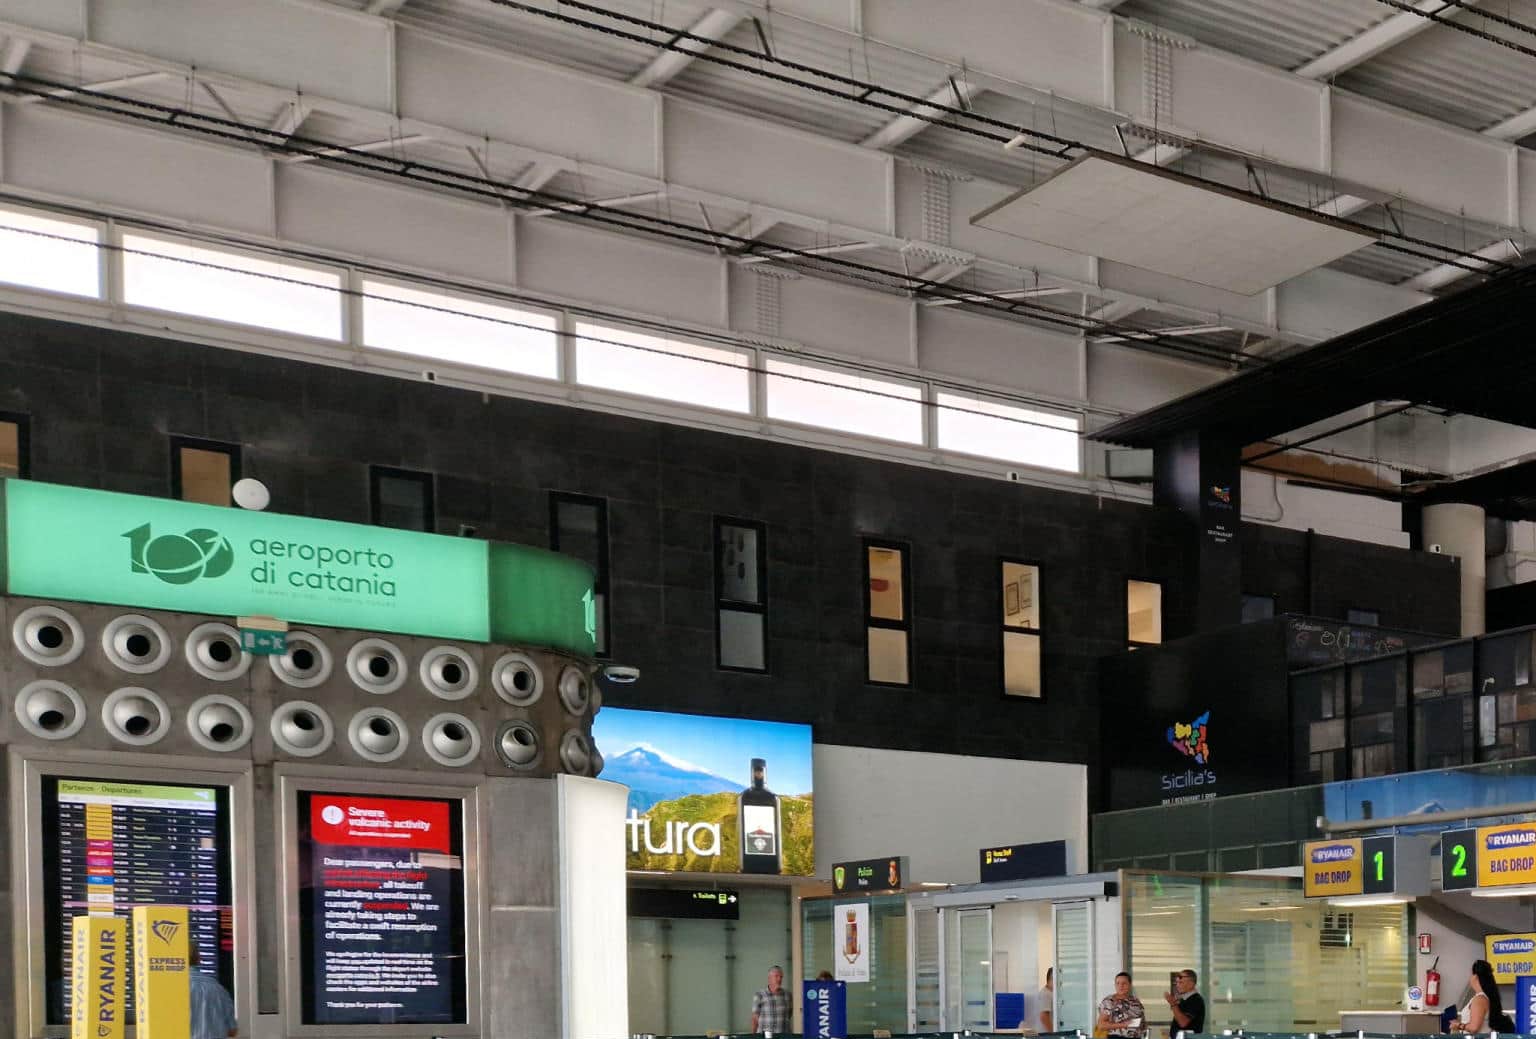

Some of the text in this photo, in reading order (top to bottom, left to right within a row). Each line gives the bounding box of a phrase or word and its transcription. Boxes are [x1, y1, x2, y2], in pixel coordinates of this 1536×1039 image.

[250, 537, 394, 569] aeroporto
[250, 561, 396, 597] di catania
[1161, 768, 1217, 790] Sicilia's
[348, 818, 431, 833] volcanic activity
[1317, 847, 1353, 860] RYANAIR
[1452, 832, 1536, 876] 2 RYANAIR
[1374, 850, 1383, 881] 1
[1490, 857, 1534, 873] BAG DROP
[1315, 870, 1352, 885] BAG DROP
[1499, 941, 1534, 951] RYANAIR
[99, 929, 116, 1022] RYANAIR
[1513, 961, 1533, 973] DROP
